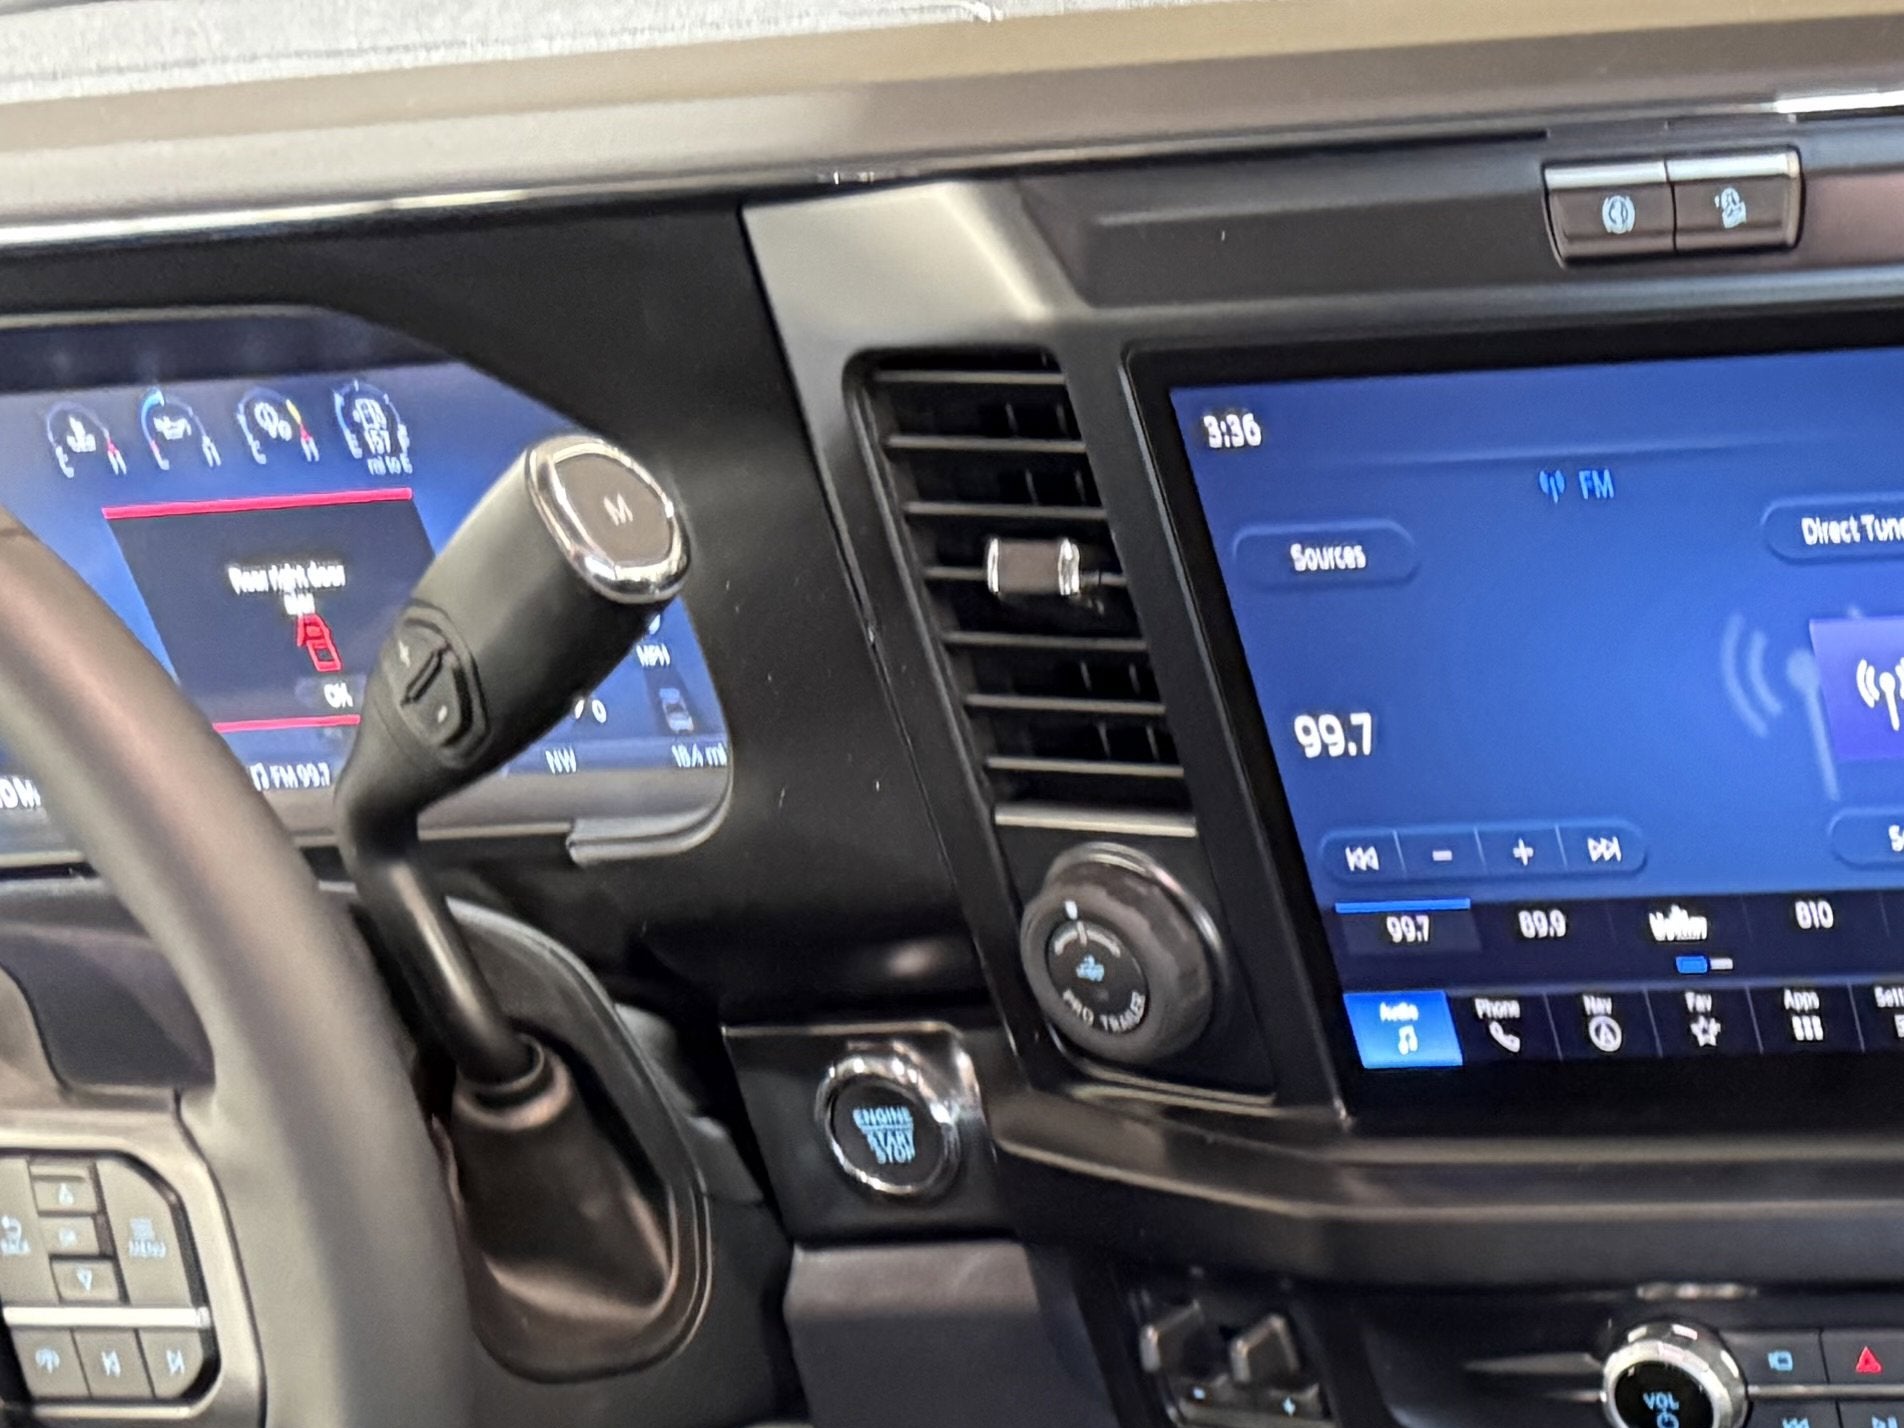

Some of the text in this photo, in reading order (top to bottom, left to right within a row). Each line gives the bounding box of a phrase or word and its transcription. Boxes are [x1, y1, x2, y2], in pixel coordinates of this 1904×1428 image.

[1203, 413, 1262, 448] 3:36
[1579, 469, 1615, 500] FM
[603, 493, 634, 525] M
[1801, 514, 1860, 546] Direct
[1290, 543, 1366, 572] Sources
[1294, 711, 1374, 759] 99.7
[1386, 914, 1431, 943] 99.7
[1475, 996, 1522, 1019] Phone
[1784, 988, 1821, 1011] Apps
[1642, 1391, 1680, 1410] VOL
